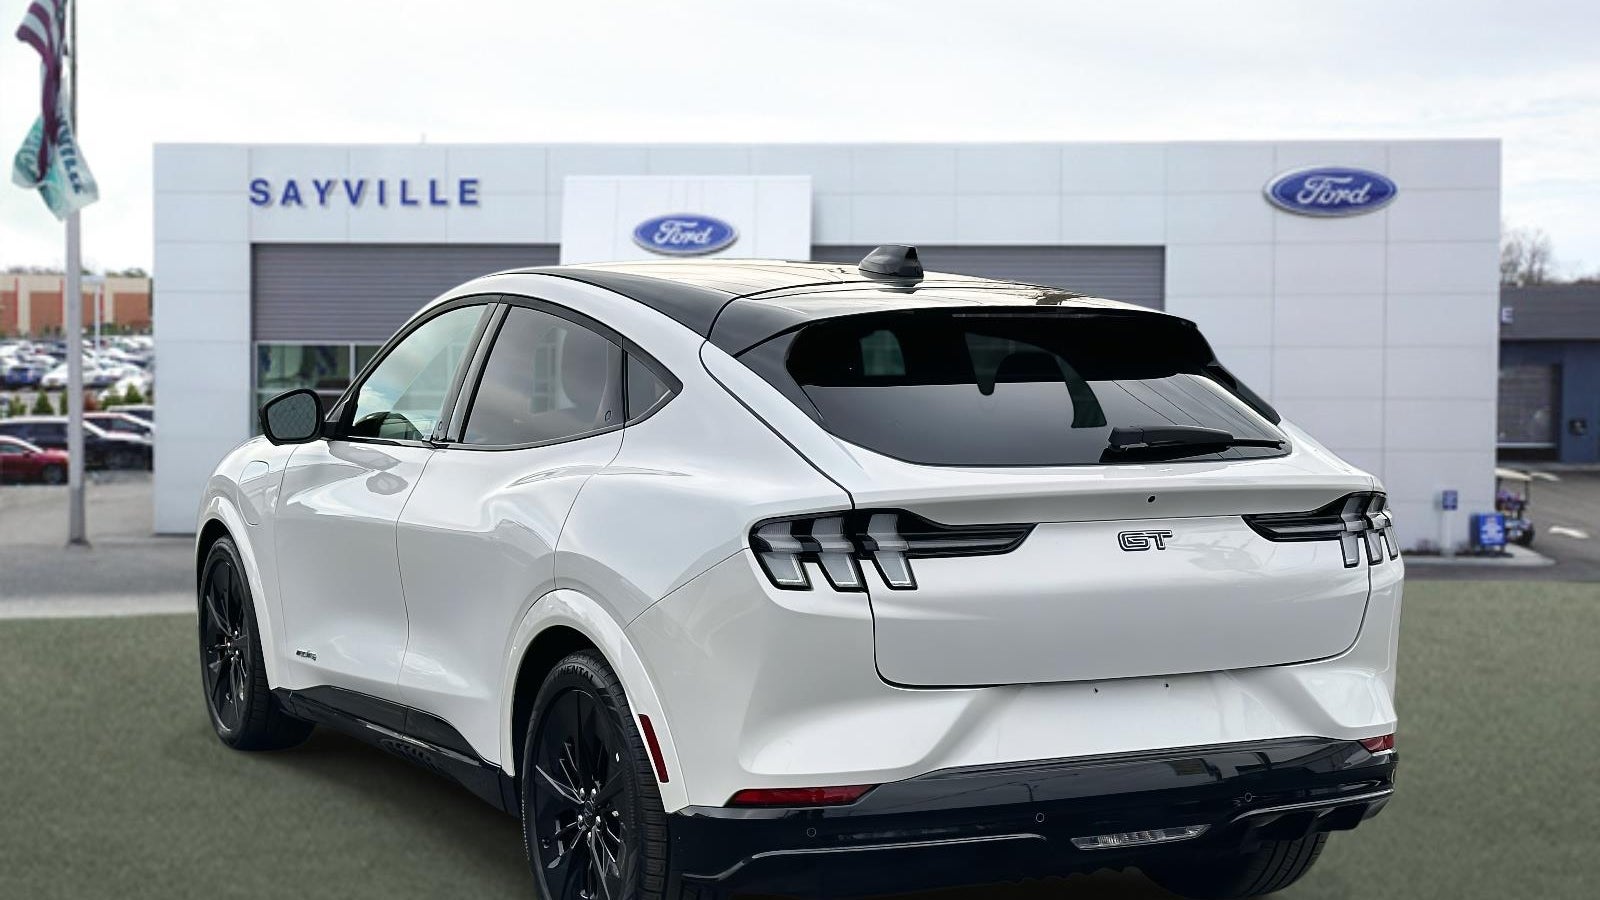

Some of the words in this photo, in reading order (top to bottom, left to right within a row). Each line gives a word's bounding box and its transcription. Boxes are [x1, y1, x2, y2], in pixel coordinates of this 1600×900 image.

[249, 178, 480, 206] SAYVILLE
[1296, 175, 1371, 204] Ford
[654, 219, 713, 244] Ford
[1118, 529, 1173, 552] GT
